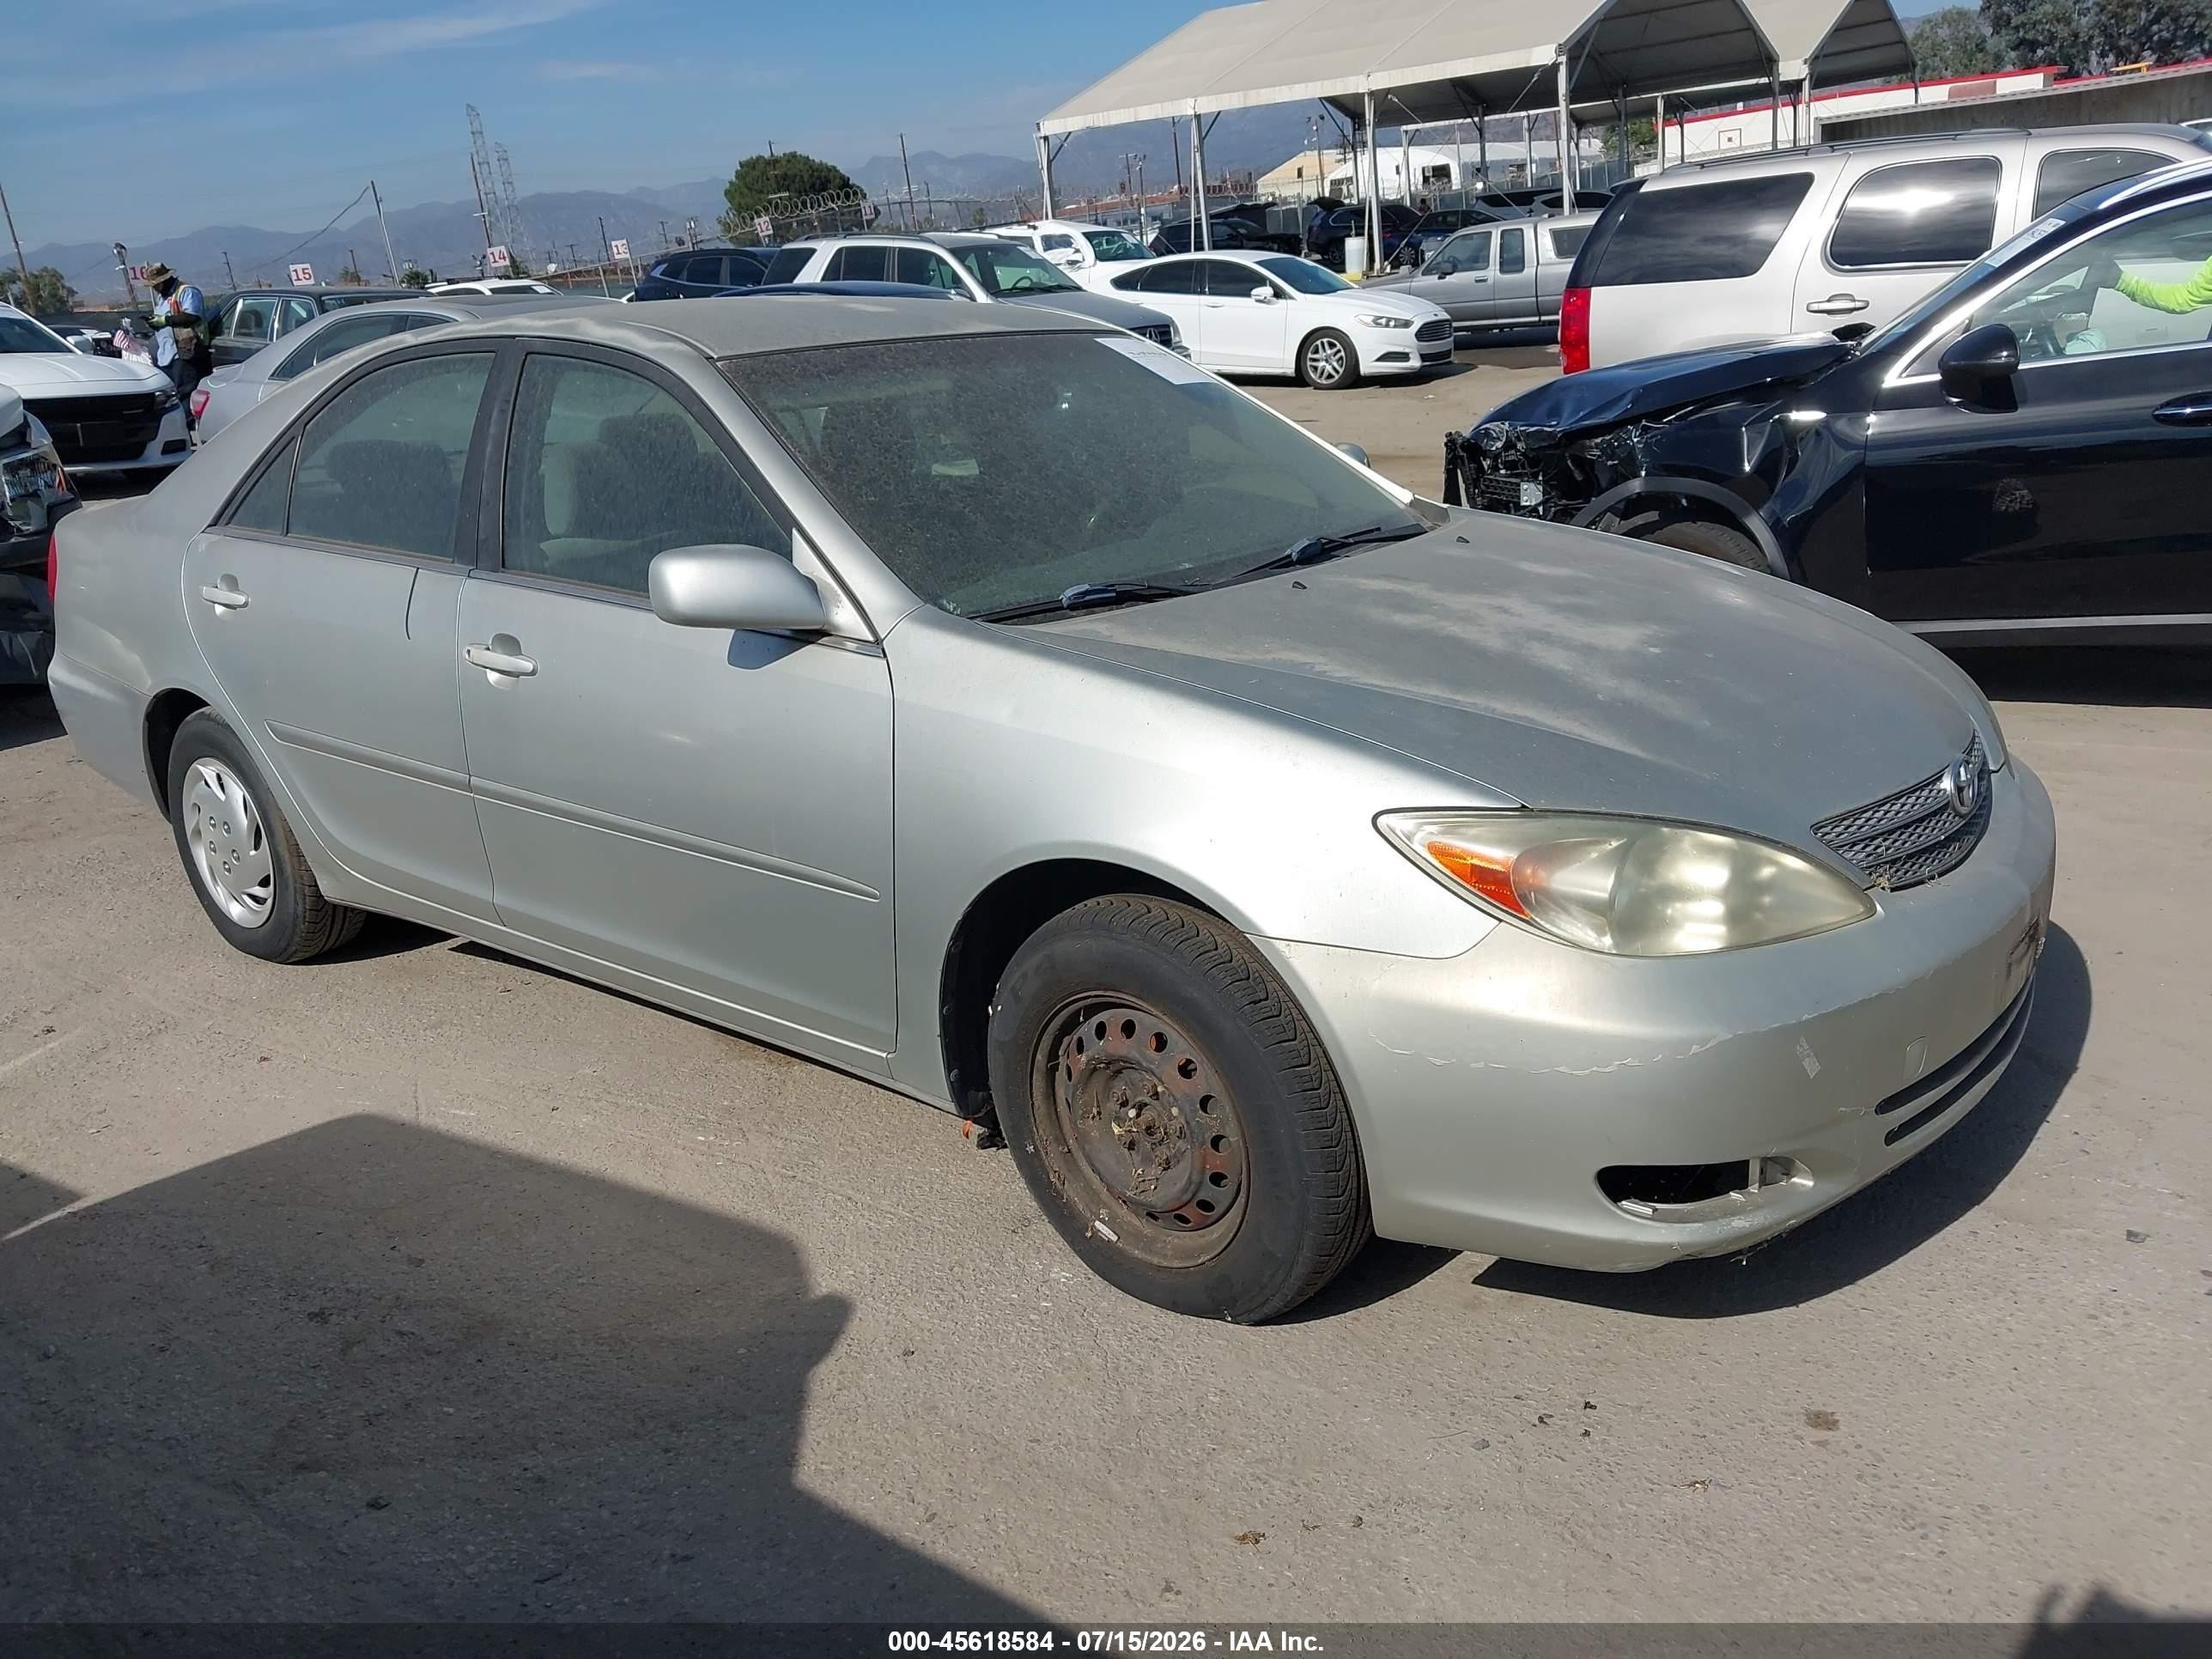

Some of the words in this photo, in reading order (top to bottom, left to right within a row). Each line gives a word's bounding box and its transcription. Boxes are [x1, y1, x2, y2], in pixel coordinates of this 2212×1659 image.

[757, 220, 771, 233] 12
[613, 243, 629, 255] 13
[489, 249, 507, 263] 14
[292, 267, 313, 282] 15
